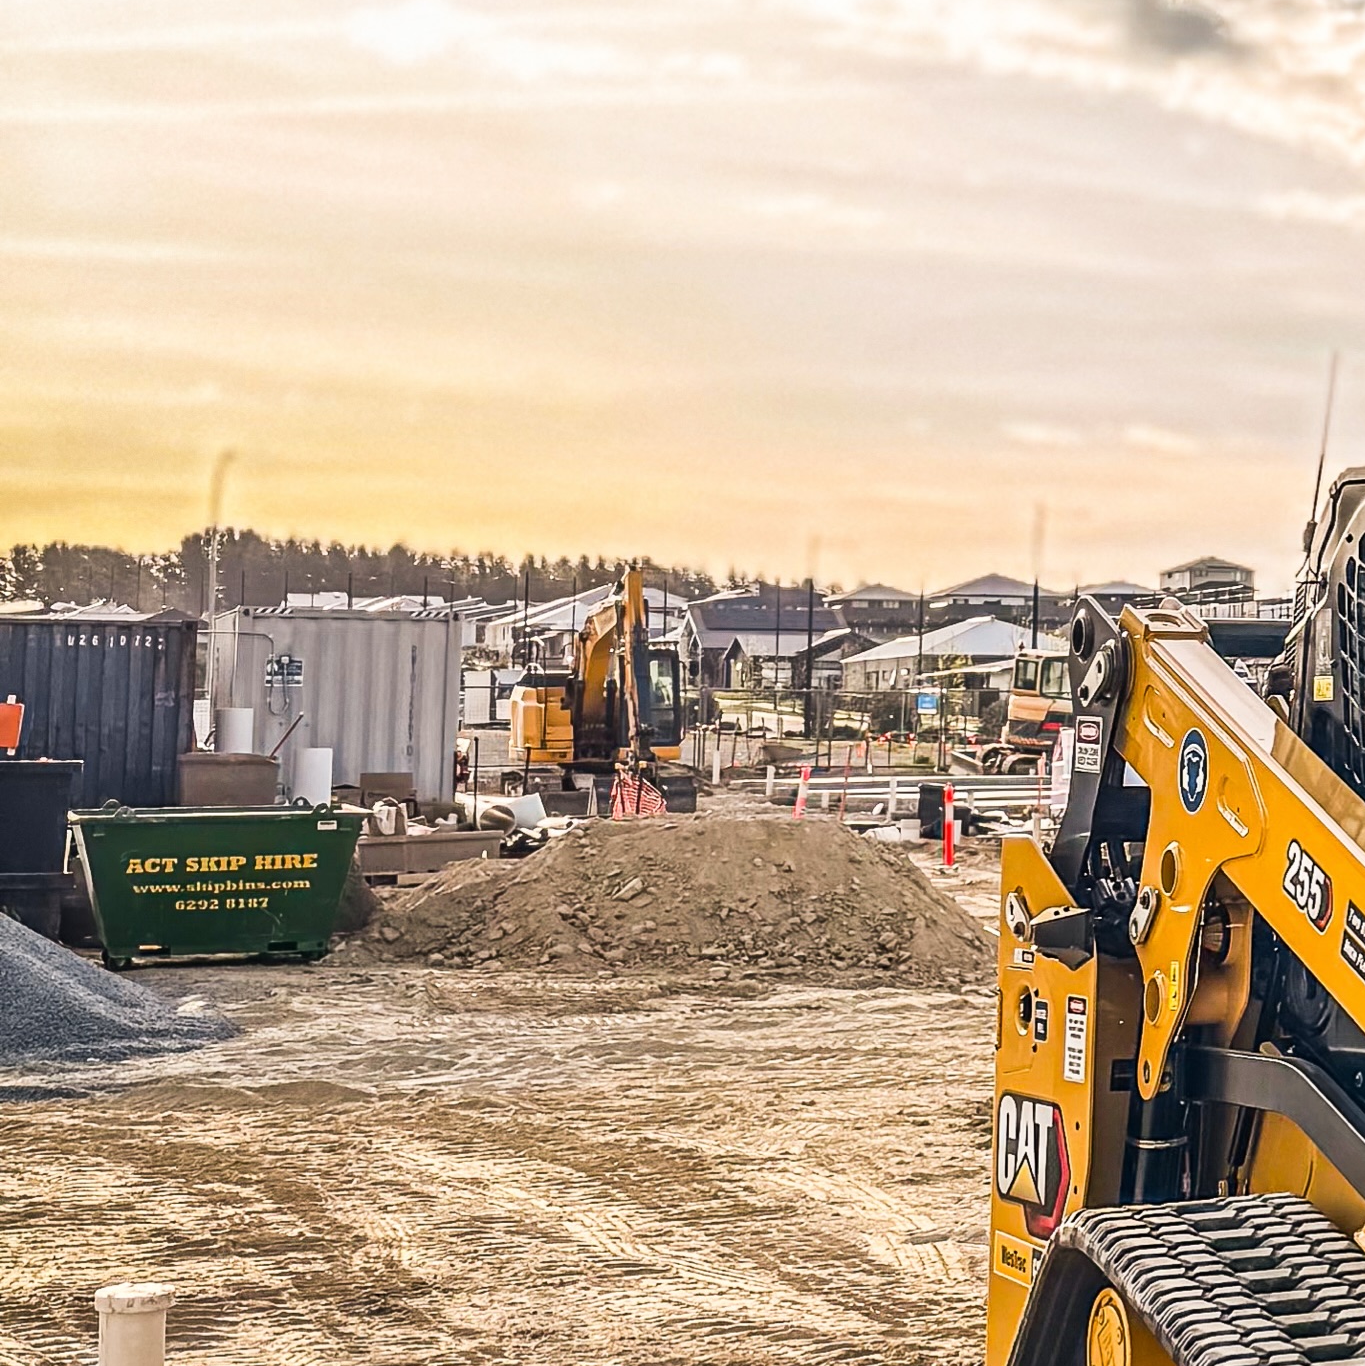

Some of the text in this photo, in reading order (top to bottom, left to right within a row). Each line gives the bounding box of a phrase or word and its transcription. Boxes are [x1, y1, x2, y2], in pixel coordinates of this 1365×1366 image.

[126, 853, 318, 874] ACT SKIP HIRE
[132, 879, 311, 894] www.skipbins.com
[1284, 841, 1325, 920] 255
[175, 897, 269, 910] 6292 8187
[998, 1094, 1054, 1206] CAT
